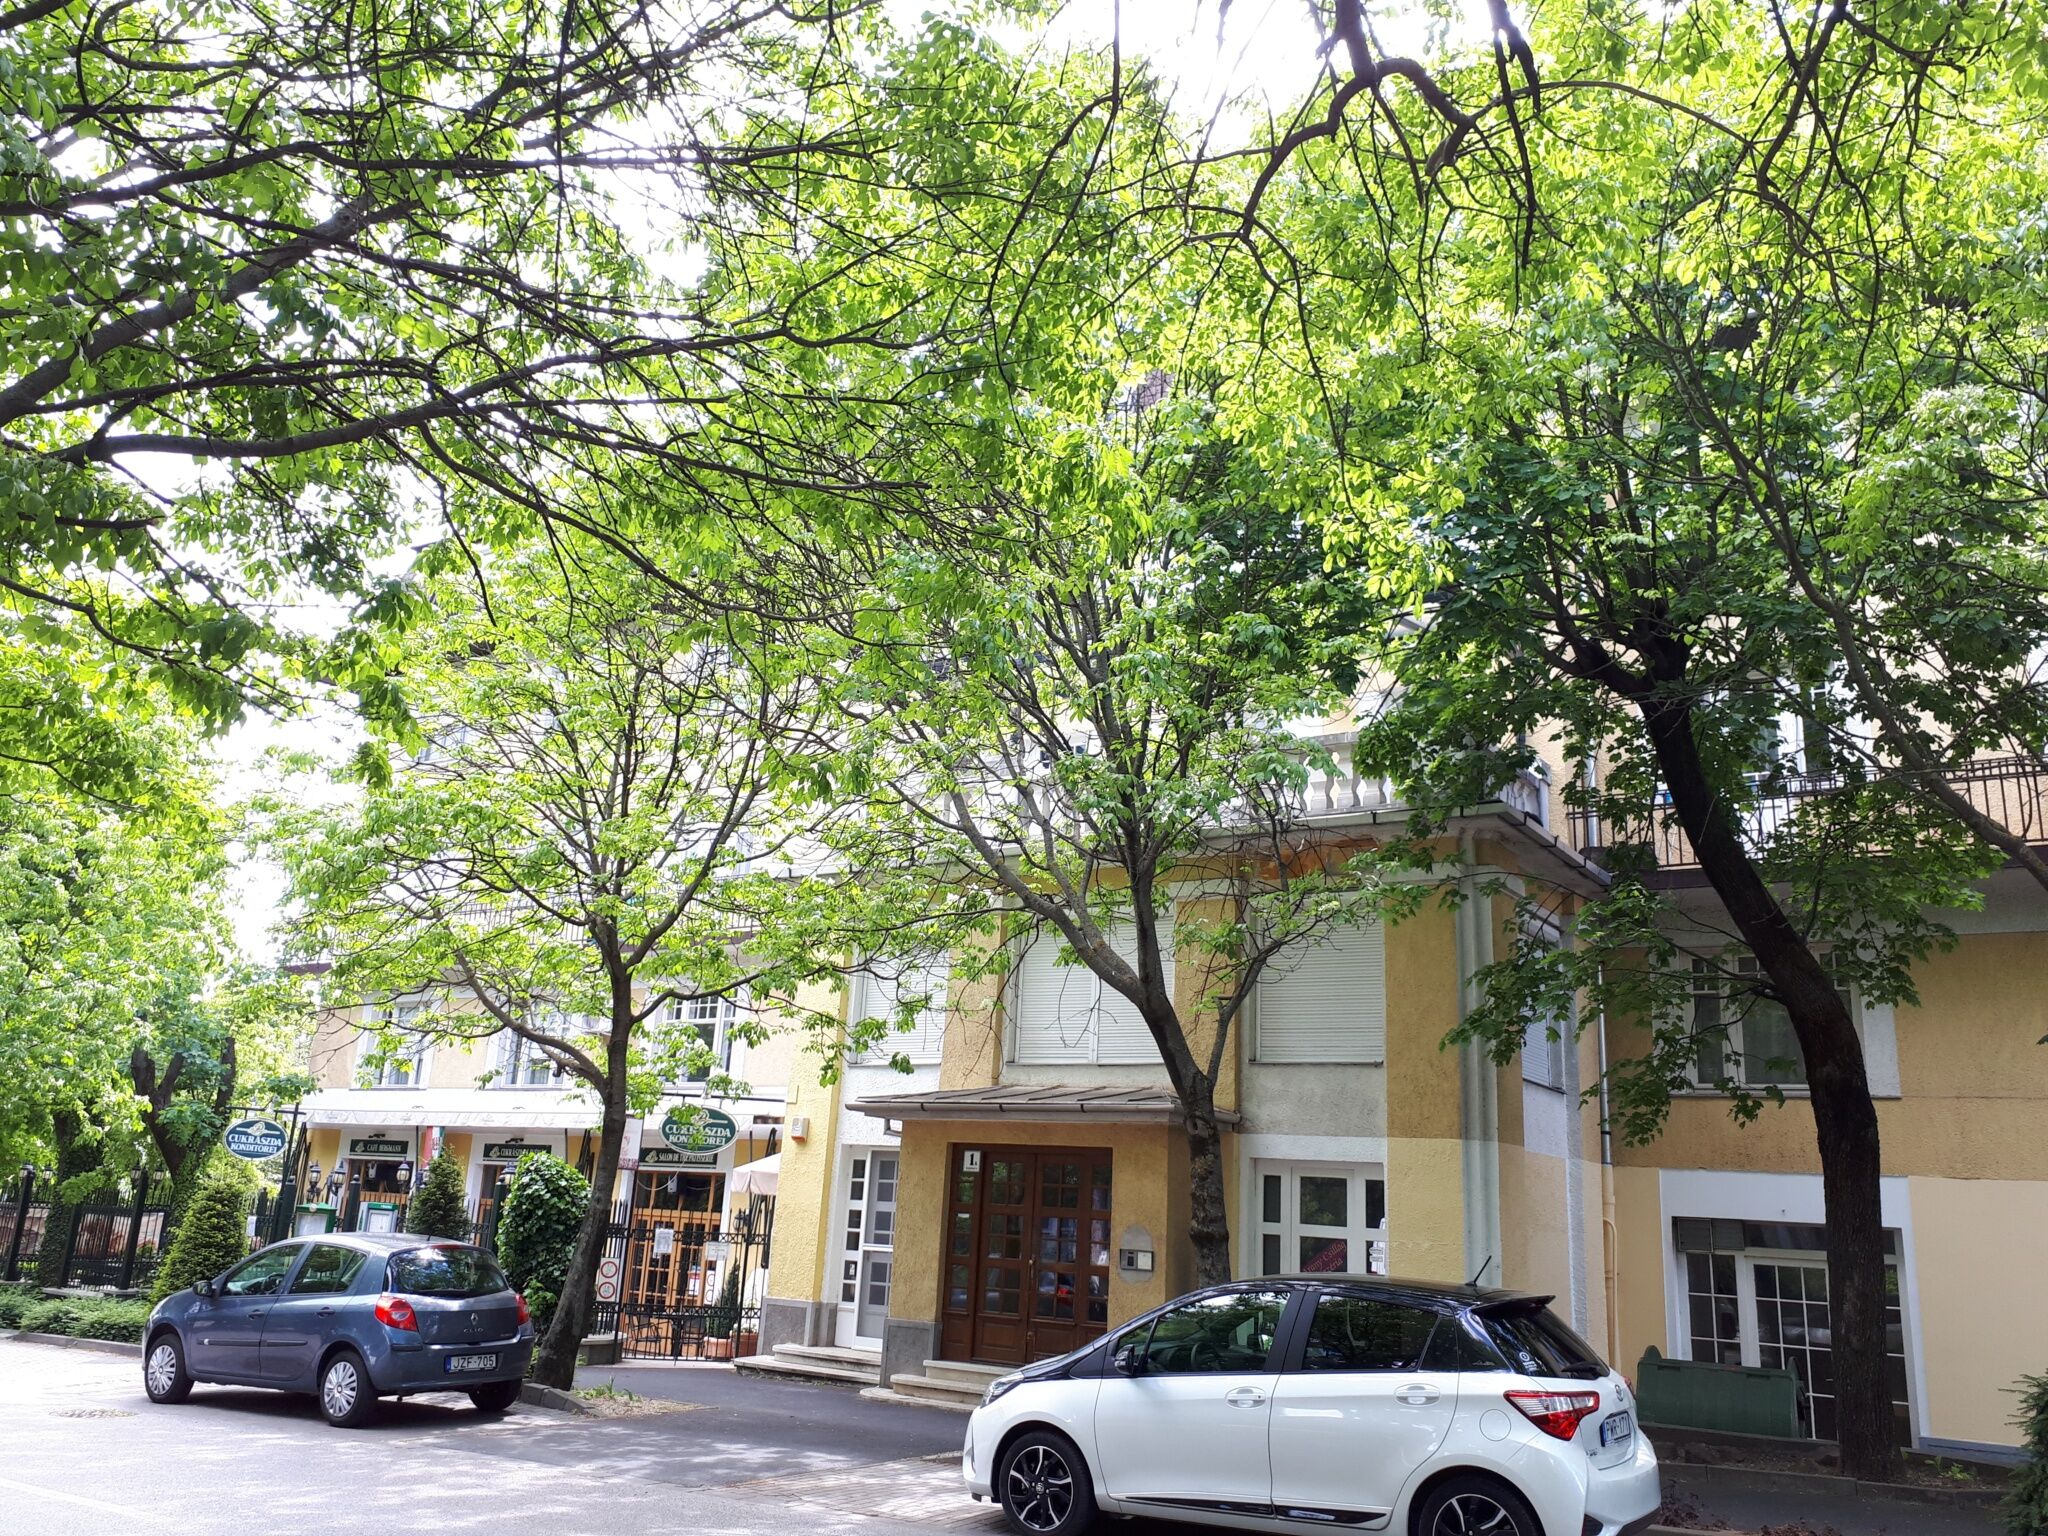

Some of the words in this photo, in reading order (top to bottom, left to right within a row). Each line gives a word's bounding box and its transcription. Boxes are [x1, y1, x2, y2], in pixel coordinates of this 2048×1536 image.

[668, 1134, 726, 1146] KONOREI
[230, 1142, 278, 1154] KONDITOREI
[453, 1355, 494, 1369] JZF-705
